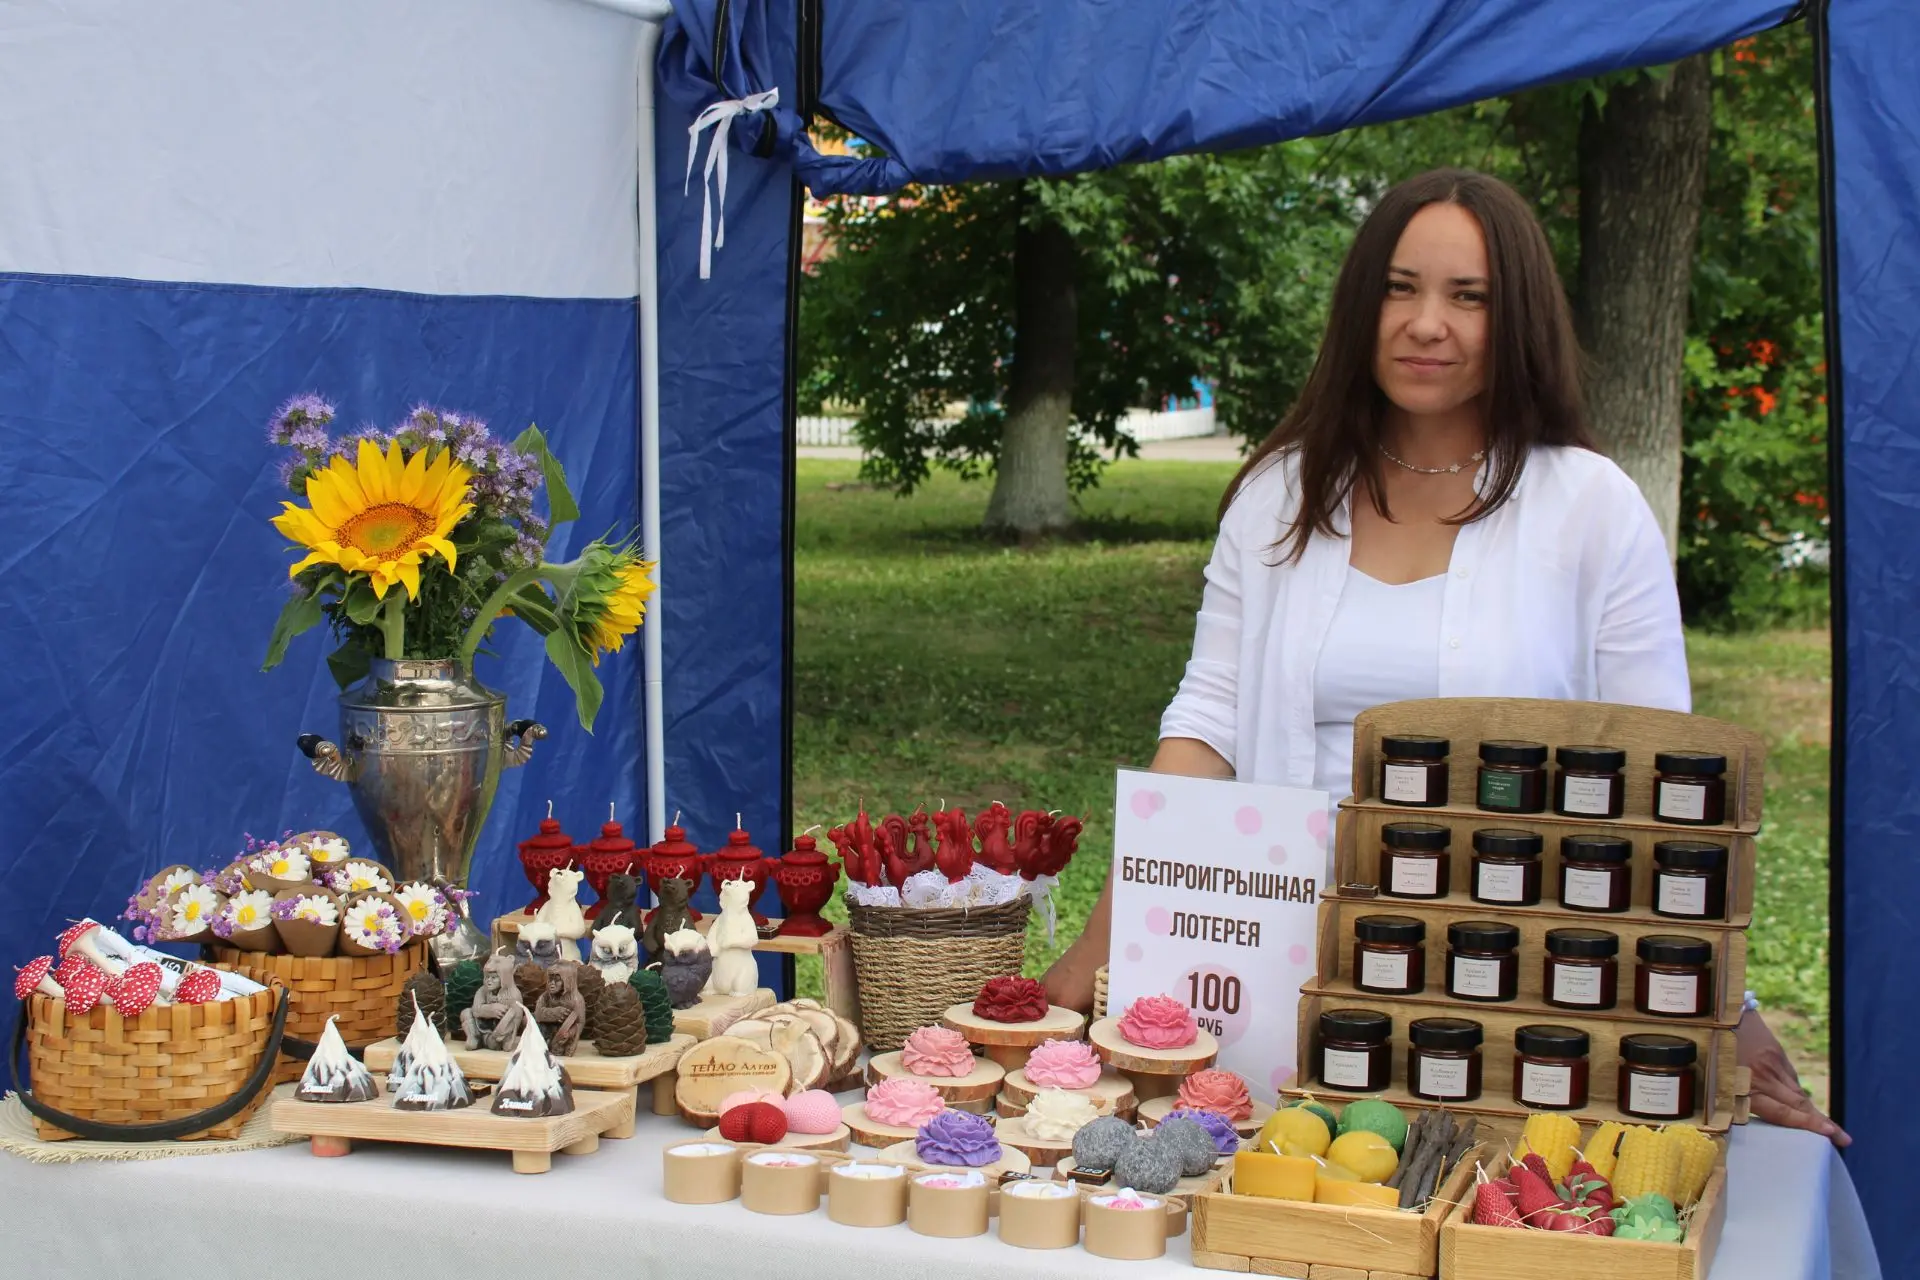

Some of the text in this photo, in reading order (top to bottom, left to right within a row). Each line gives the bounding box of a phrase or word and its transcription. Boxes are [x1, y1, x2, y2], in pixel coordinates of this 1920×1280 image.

[1122, 855, 1316, 905] БЕСПРОИГРЫШНАЯ
[1169, 911, 1261, 948] ЛОТЕРЕЯ
[1188, 971, 1241, 1015] 100
[691, 1063, 736, 1073] ТЕПЛО
[499, 1098, 534, 1110] Алтай
